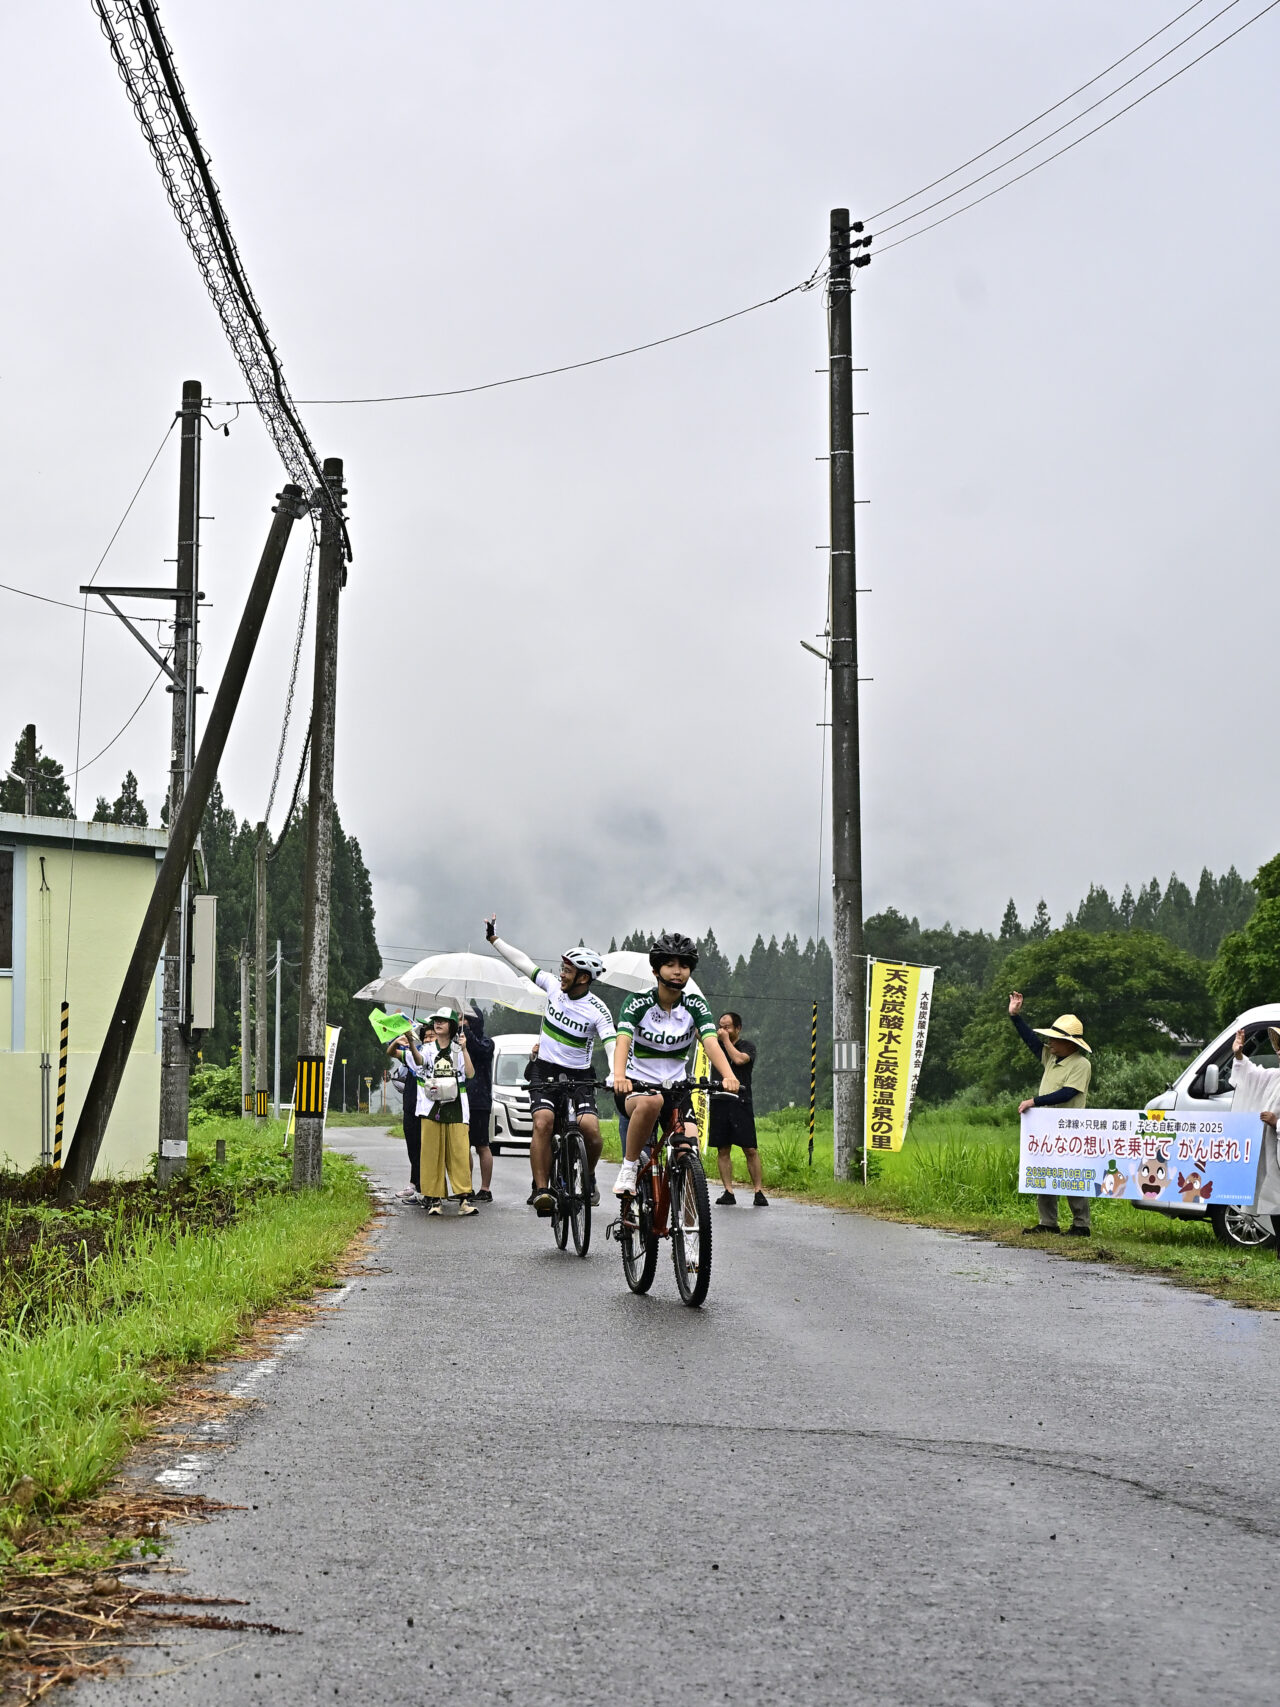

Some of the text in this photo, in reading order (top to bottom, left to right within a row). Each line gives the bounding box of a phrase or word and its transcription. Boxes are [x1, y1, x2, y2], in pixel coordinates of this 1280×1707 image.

[637, 1025, 696, 1046] Tadami
[871, 968, 910, 1150] 天然炭酸水と炭酸温泉の里
[1200, 1122, 1223, 1133] 2025
[1028, 1134, 1172, 1158] みんなの想いを乗せて
